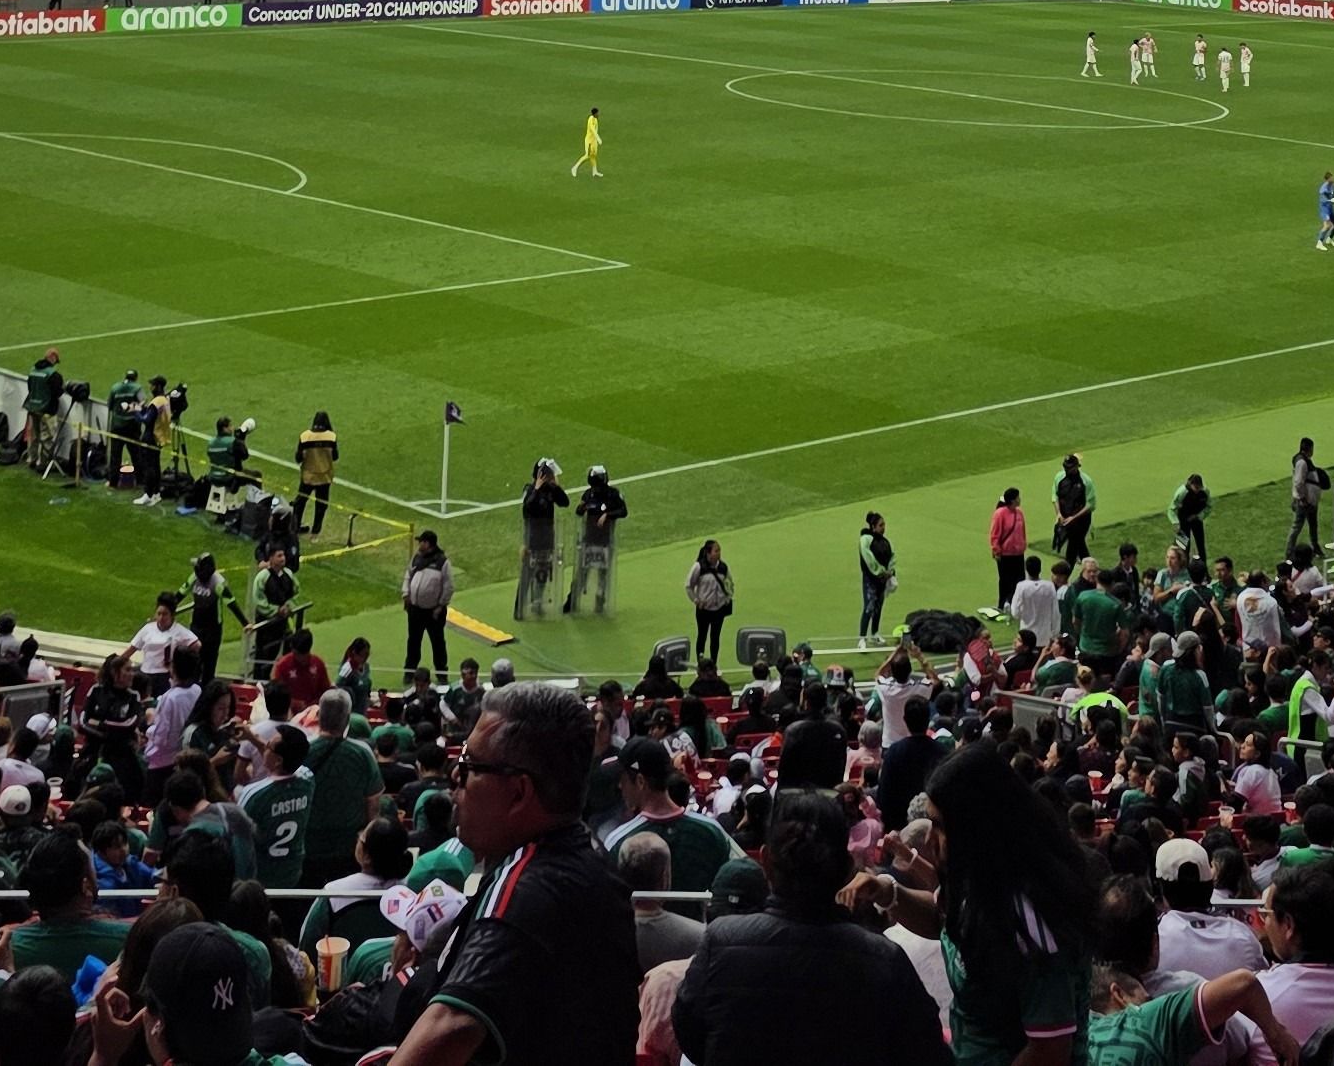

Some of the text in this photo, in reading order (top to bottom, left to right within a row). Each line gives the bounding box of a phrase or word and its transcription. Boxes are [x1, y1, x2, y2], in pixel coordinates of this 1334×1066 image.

[121, 6, 228, 30] aramco
[249, 0, 478, 23] Concacaf UNDER-20 CHAMPIONSHIP
[271, 795, 308, 817] CASTRO
[269, 820, 298, 857] 2
[212, 976, 234, 1010] NY
